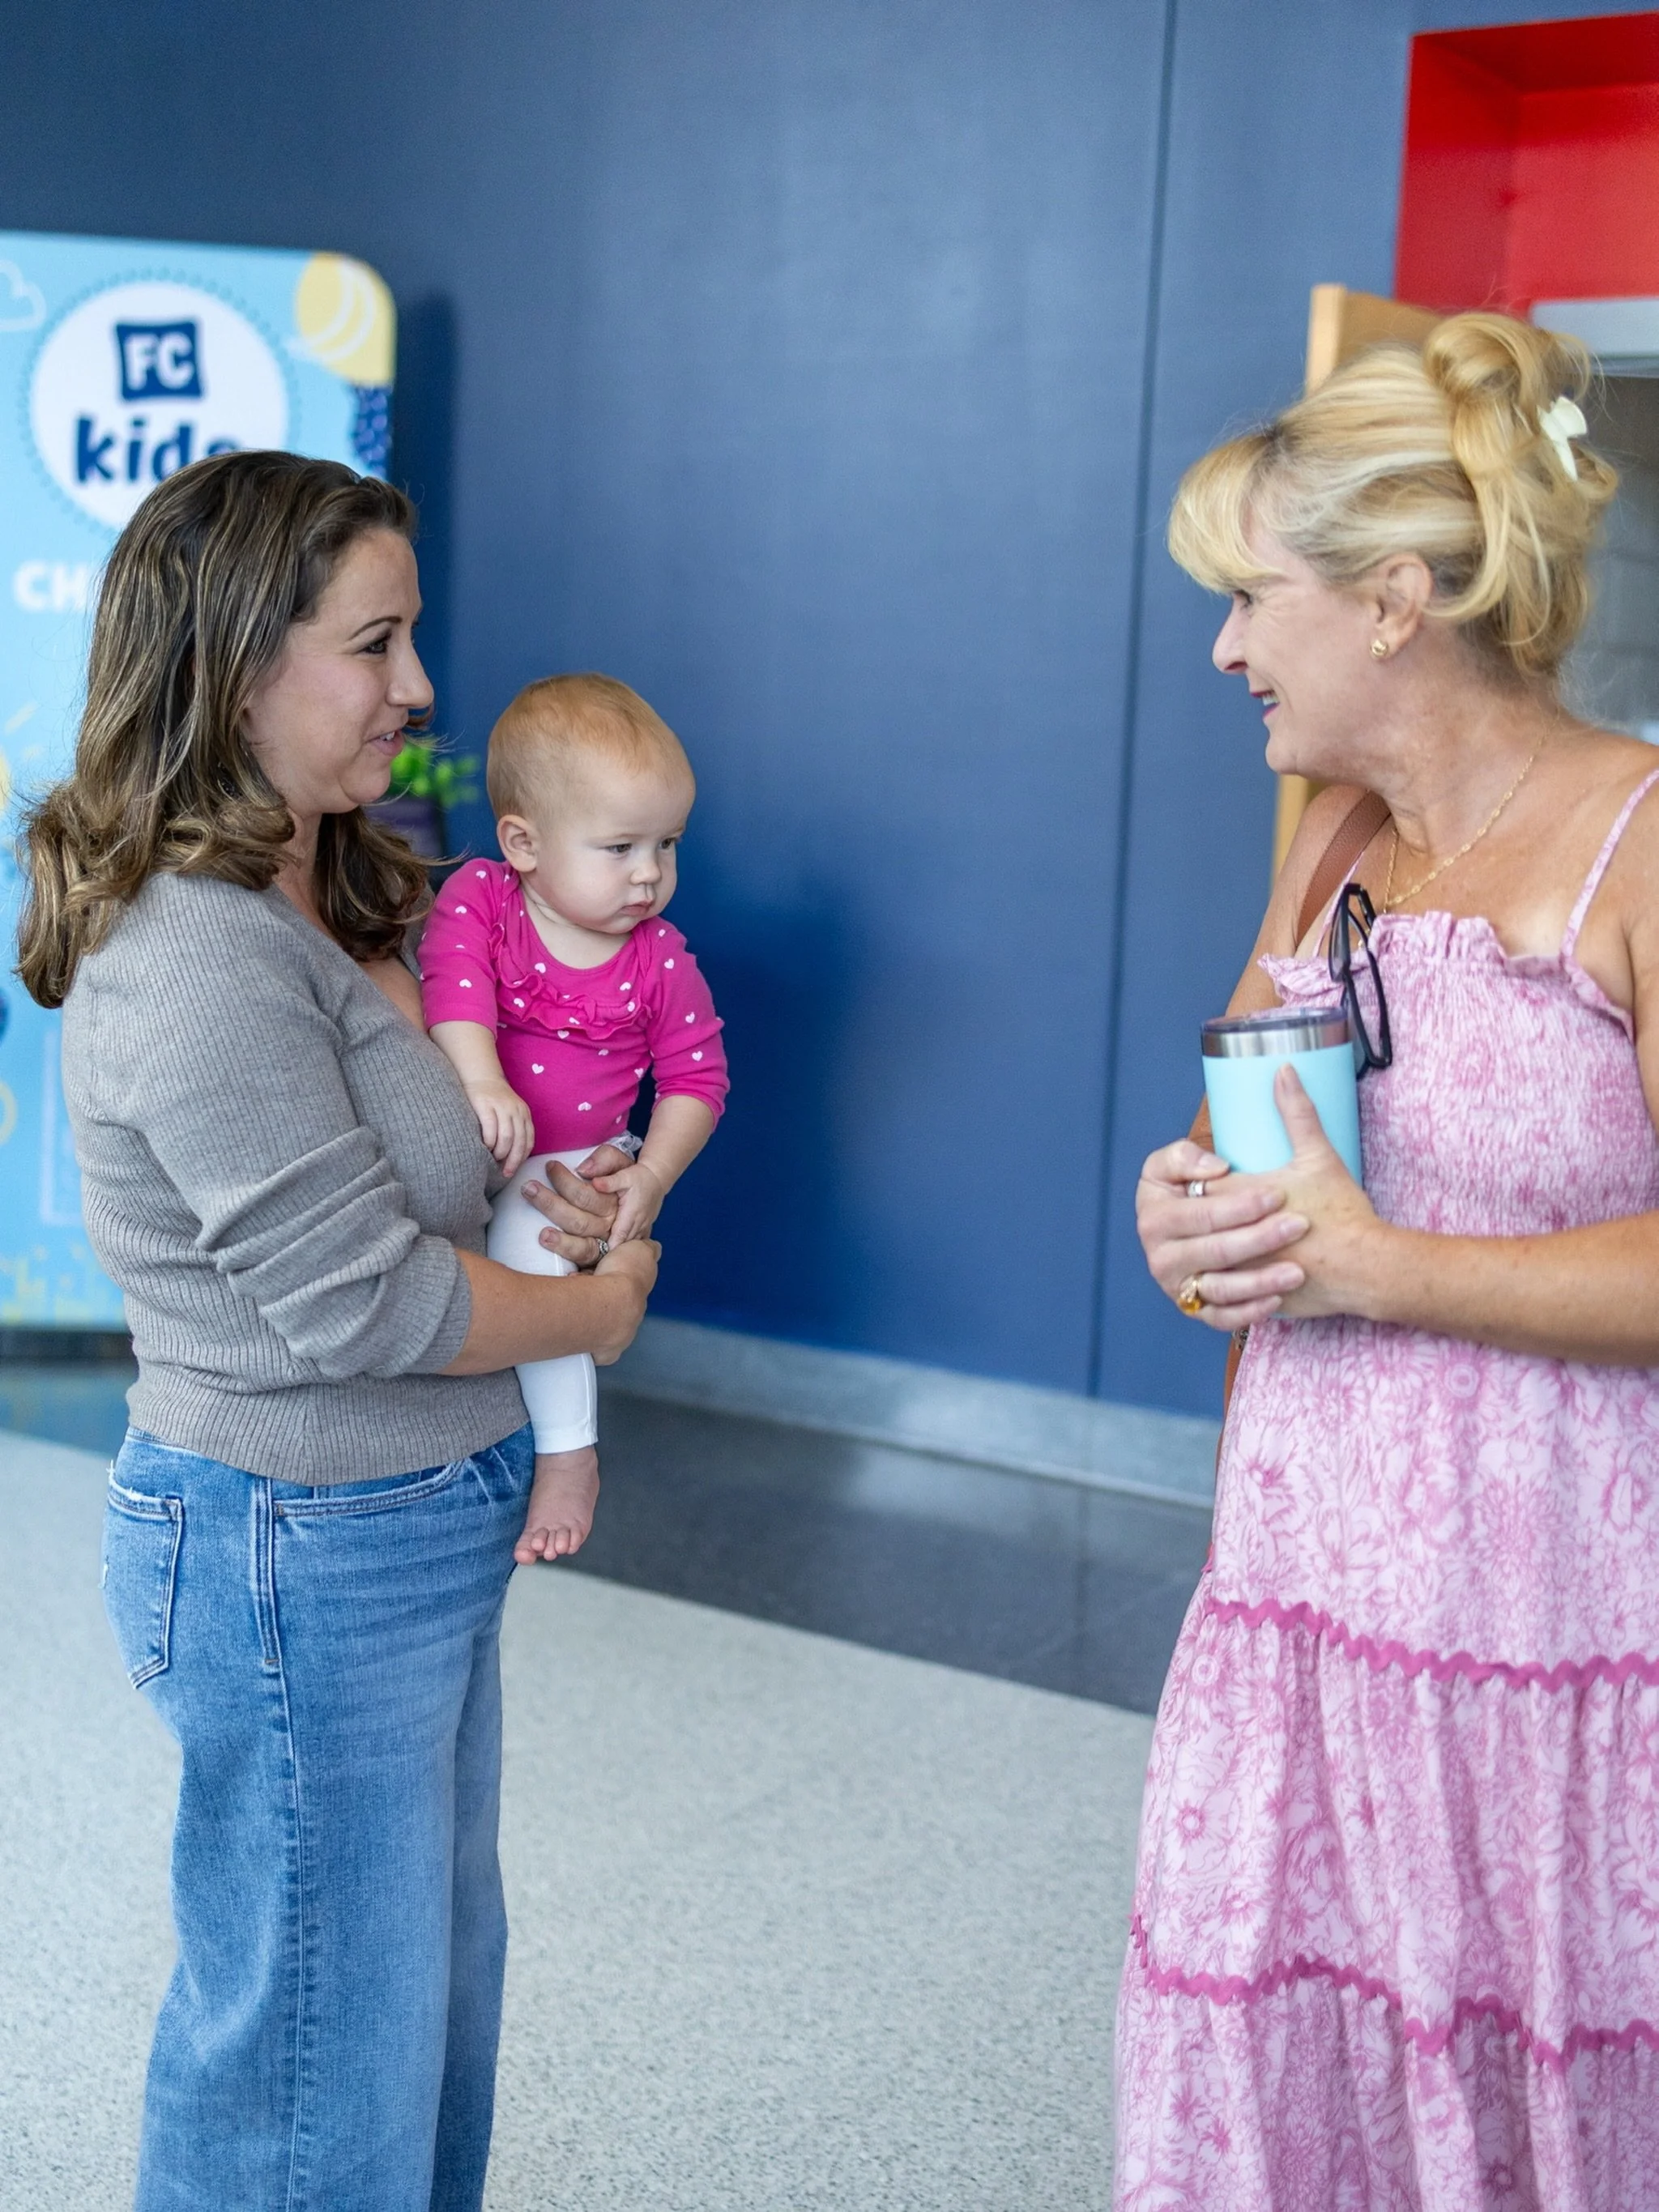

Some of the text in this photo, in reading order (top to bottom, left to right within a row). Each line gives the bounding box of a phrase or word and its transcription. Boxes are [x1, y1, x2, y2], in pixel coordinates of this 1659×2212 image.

[124, 332, 194, 389] FC
[76, 416, 241, 483] kid
[14, 560, 94, 612] CH
